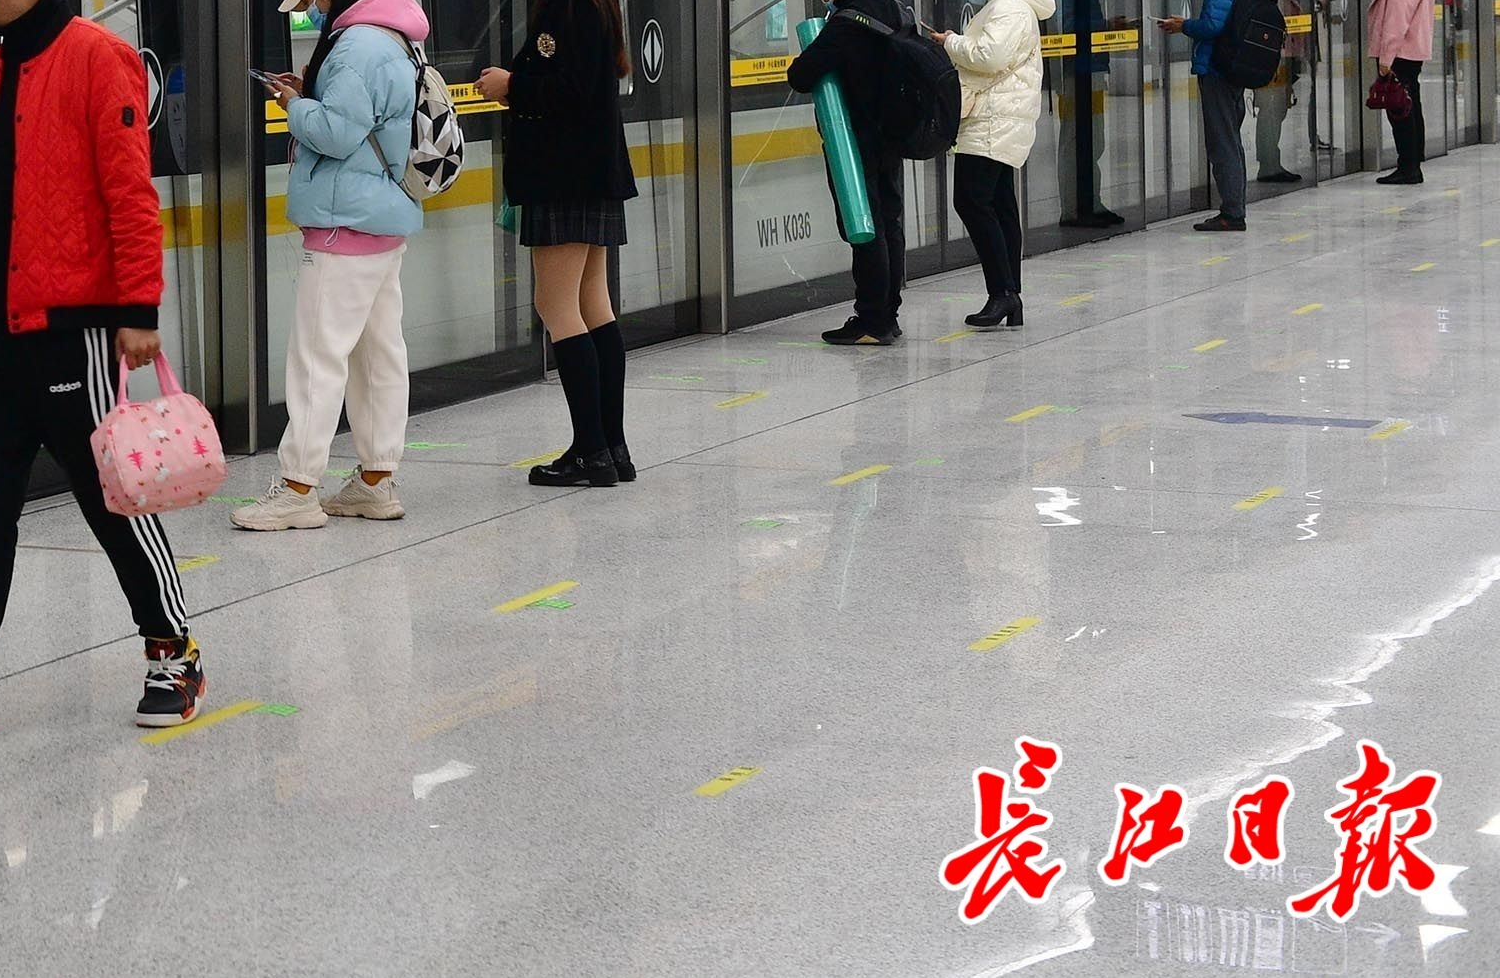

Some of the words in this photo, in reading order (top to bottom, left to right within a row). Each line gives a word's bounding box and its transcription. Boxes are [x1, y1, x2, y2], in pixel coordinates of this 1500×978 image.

[757, 216, 779, 248] WH
[783, 211, 812, 244] K036
[49, 381, 82, 393] adidas
